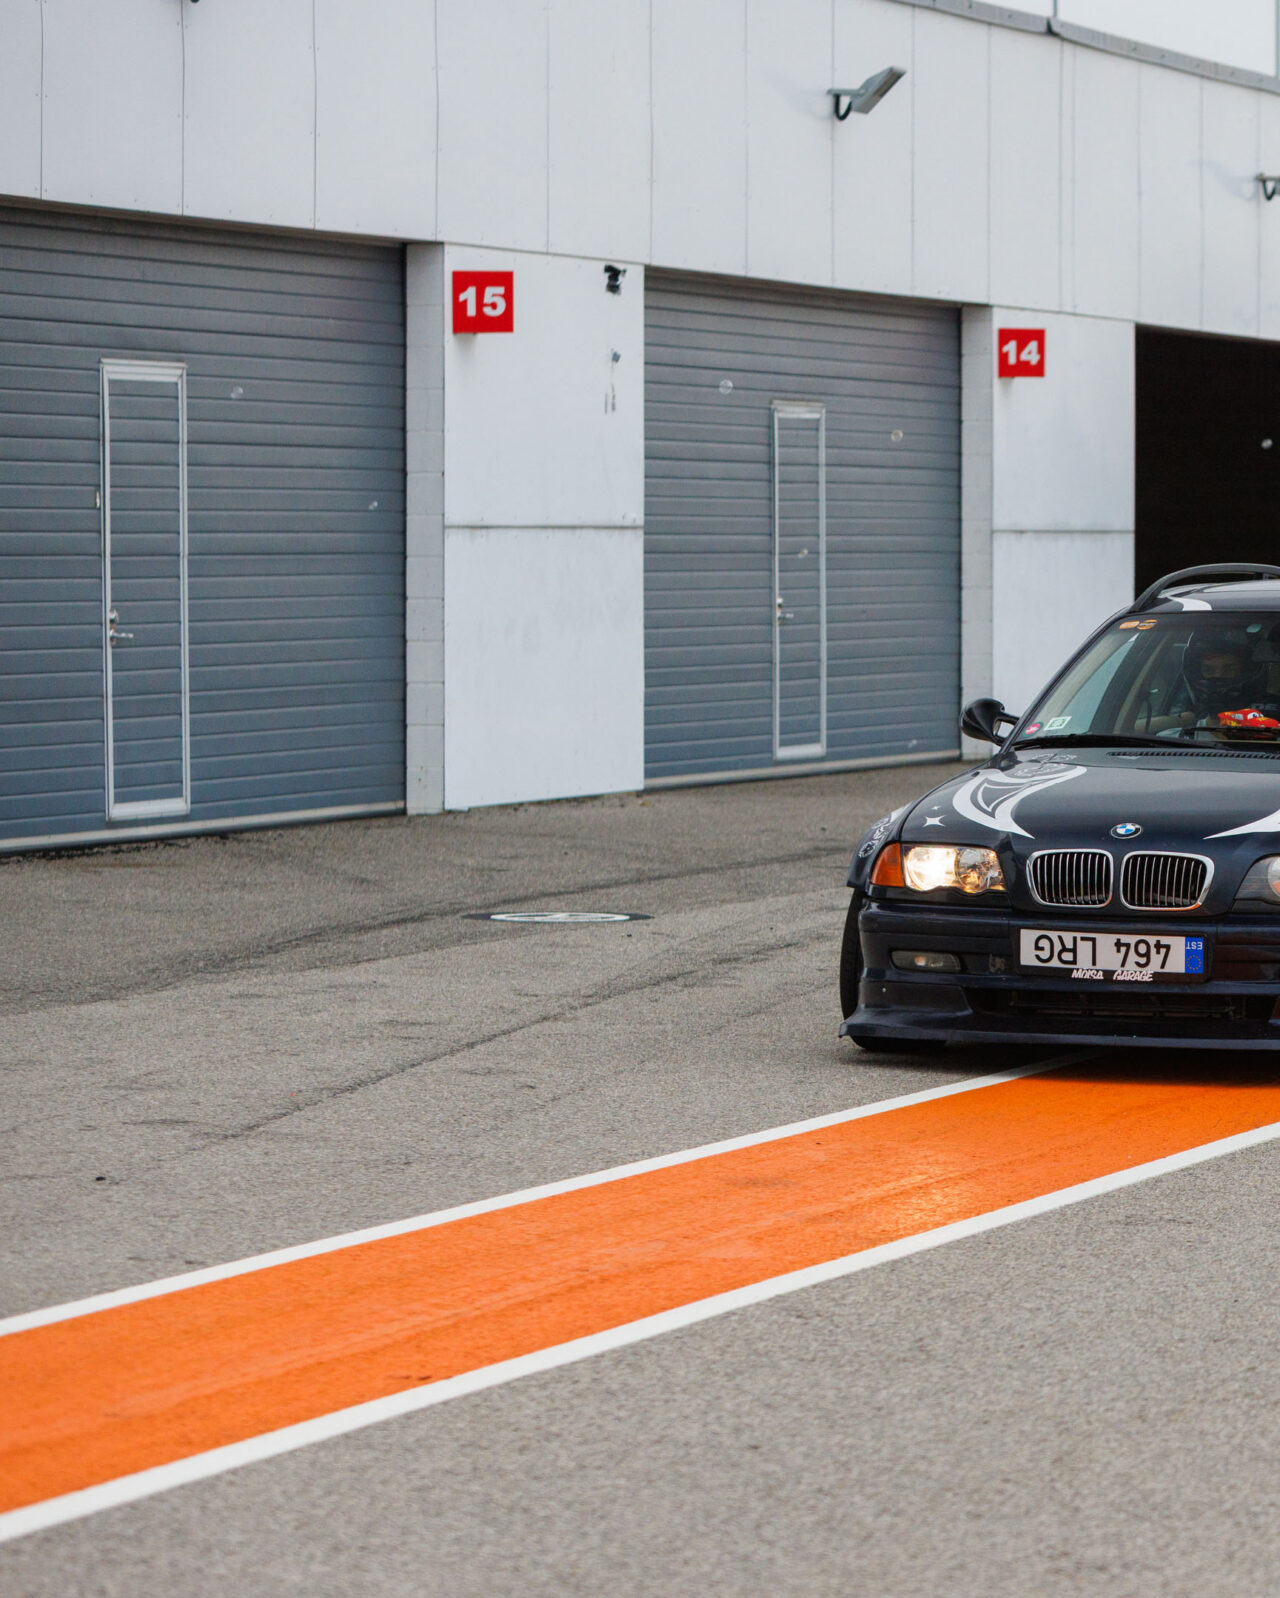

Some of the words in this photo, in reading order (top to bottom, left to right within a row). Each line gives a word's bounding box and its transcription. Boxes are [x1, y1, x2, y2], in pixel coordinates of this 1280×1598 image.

[459, 287, 506, 317] 15
[1002, 340, 1041, 366] 14
[1034, 934, 1096, 967] LRG
[1114, 937, 1171, 969] 464
[1185, 941, 1203, 950] EST
[1112, 970, 1154, 981] GARAGE
